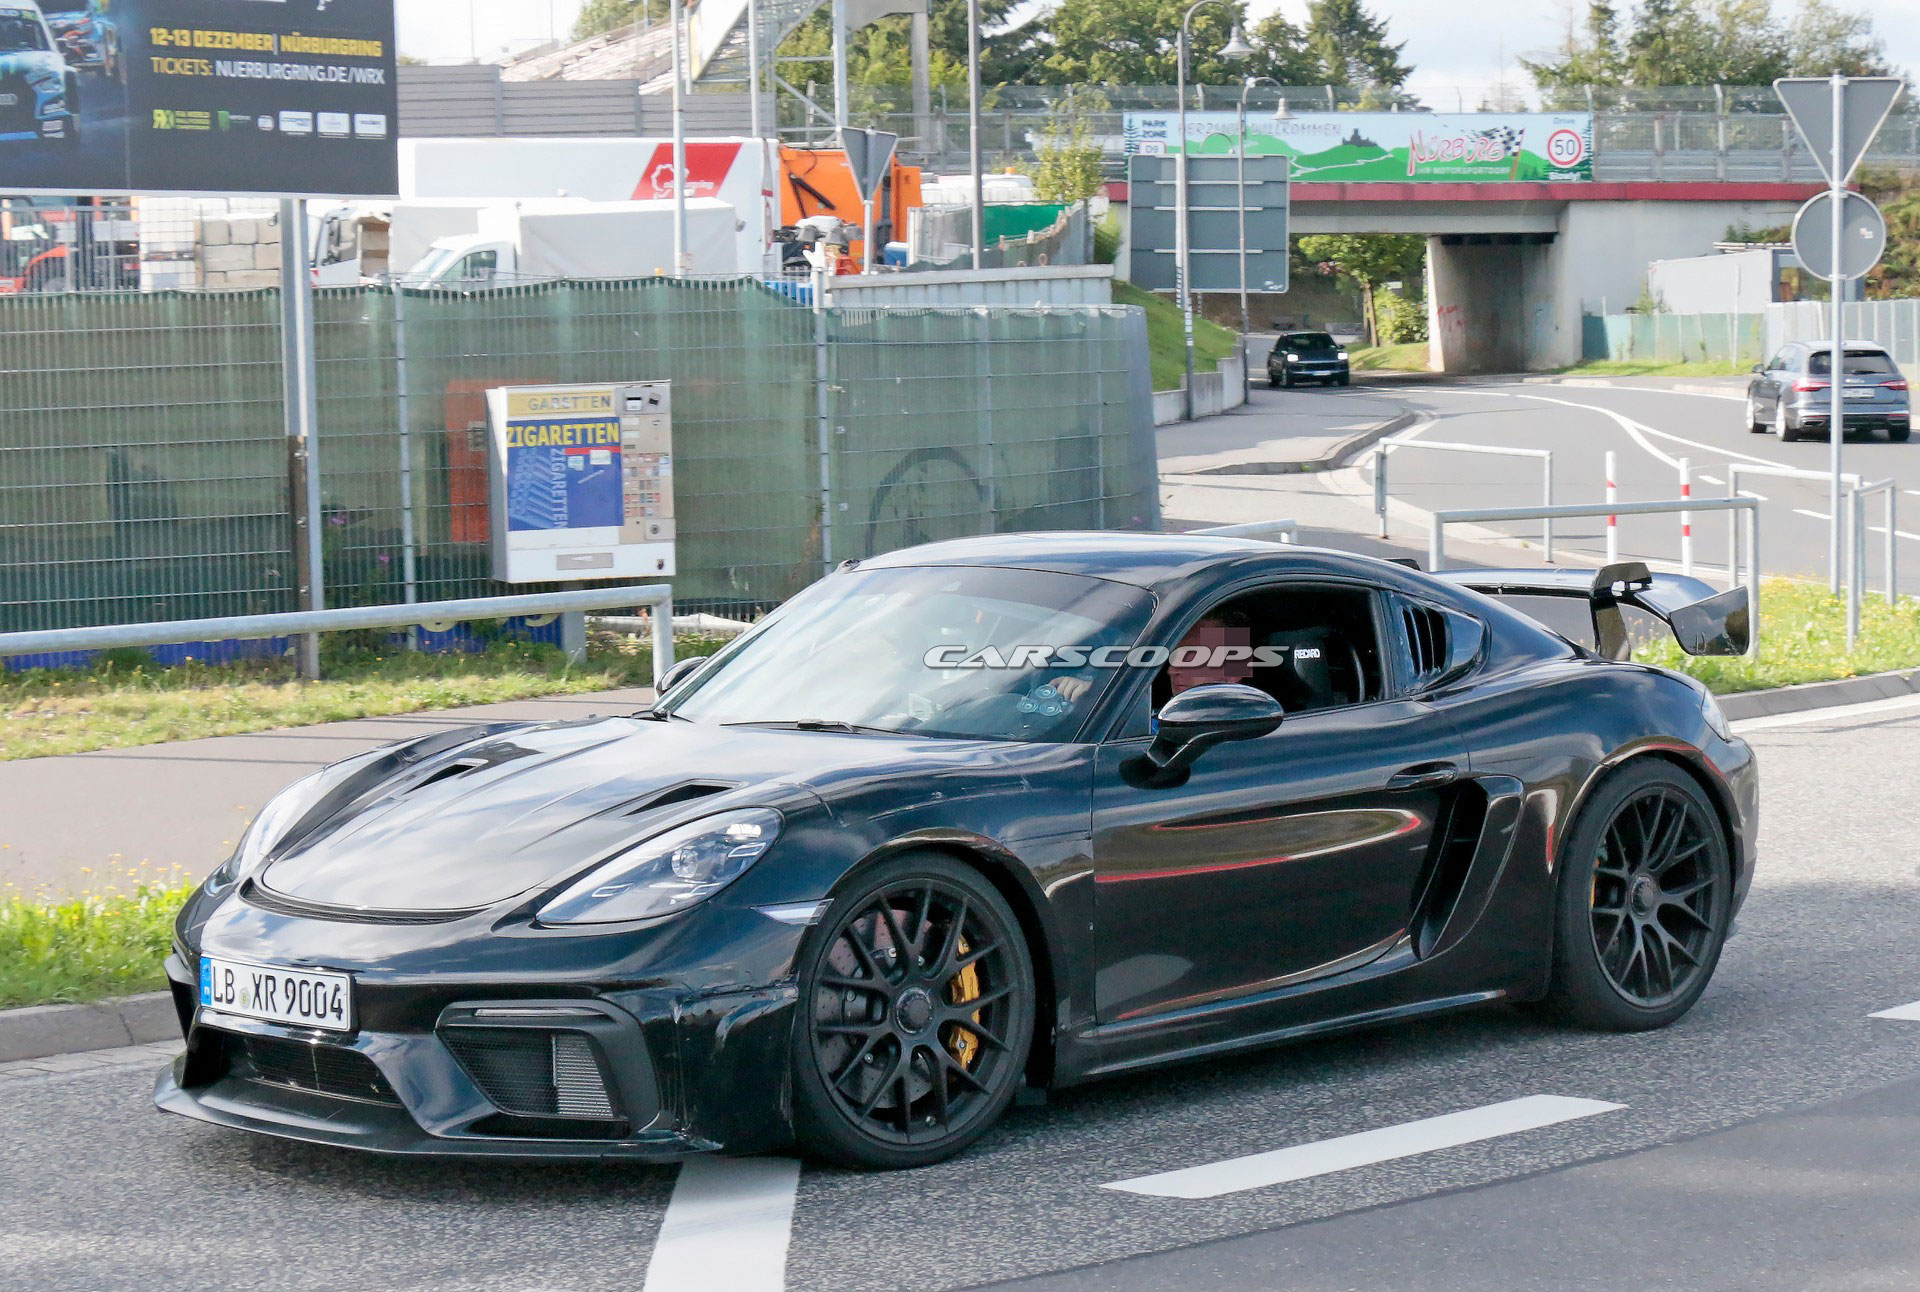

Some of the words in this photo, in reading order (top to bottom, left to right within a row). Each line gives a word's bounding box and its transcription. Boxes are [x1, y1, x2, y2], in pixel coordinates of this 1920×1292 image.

[192, 30, 273, 50] DEZEMBER
[280, 31, 383, 58] NÜRBURGRING
[149, 56, 214, 76] TICKETS:
[1142, 119, 1167, 128] PARK
[1142, 130, 1167, 138] ZONE
[1145, 144, 1159, 154] D9
[1555, 138, 1575, 156] 50
[506, 422, 620, 447] ZIGARETTEN
[251, 972, 278, 1014] XR
[284, 977, 344, 1022] 9004
